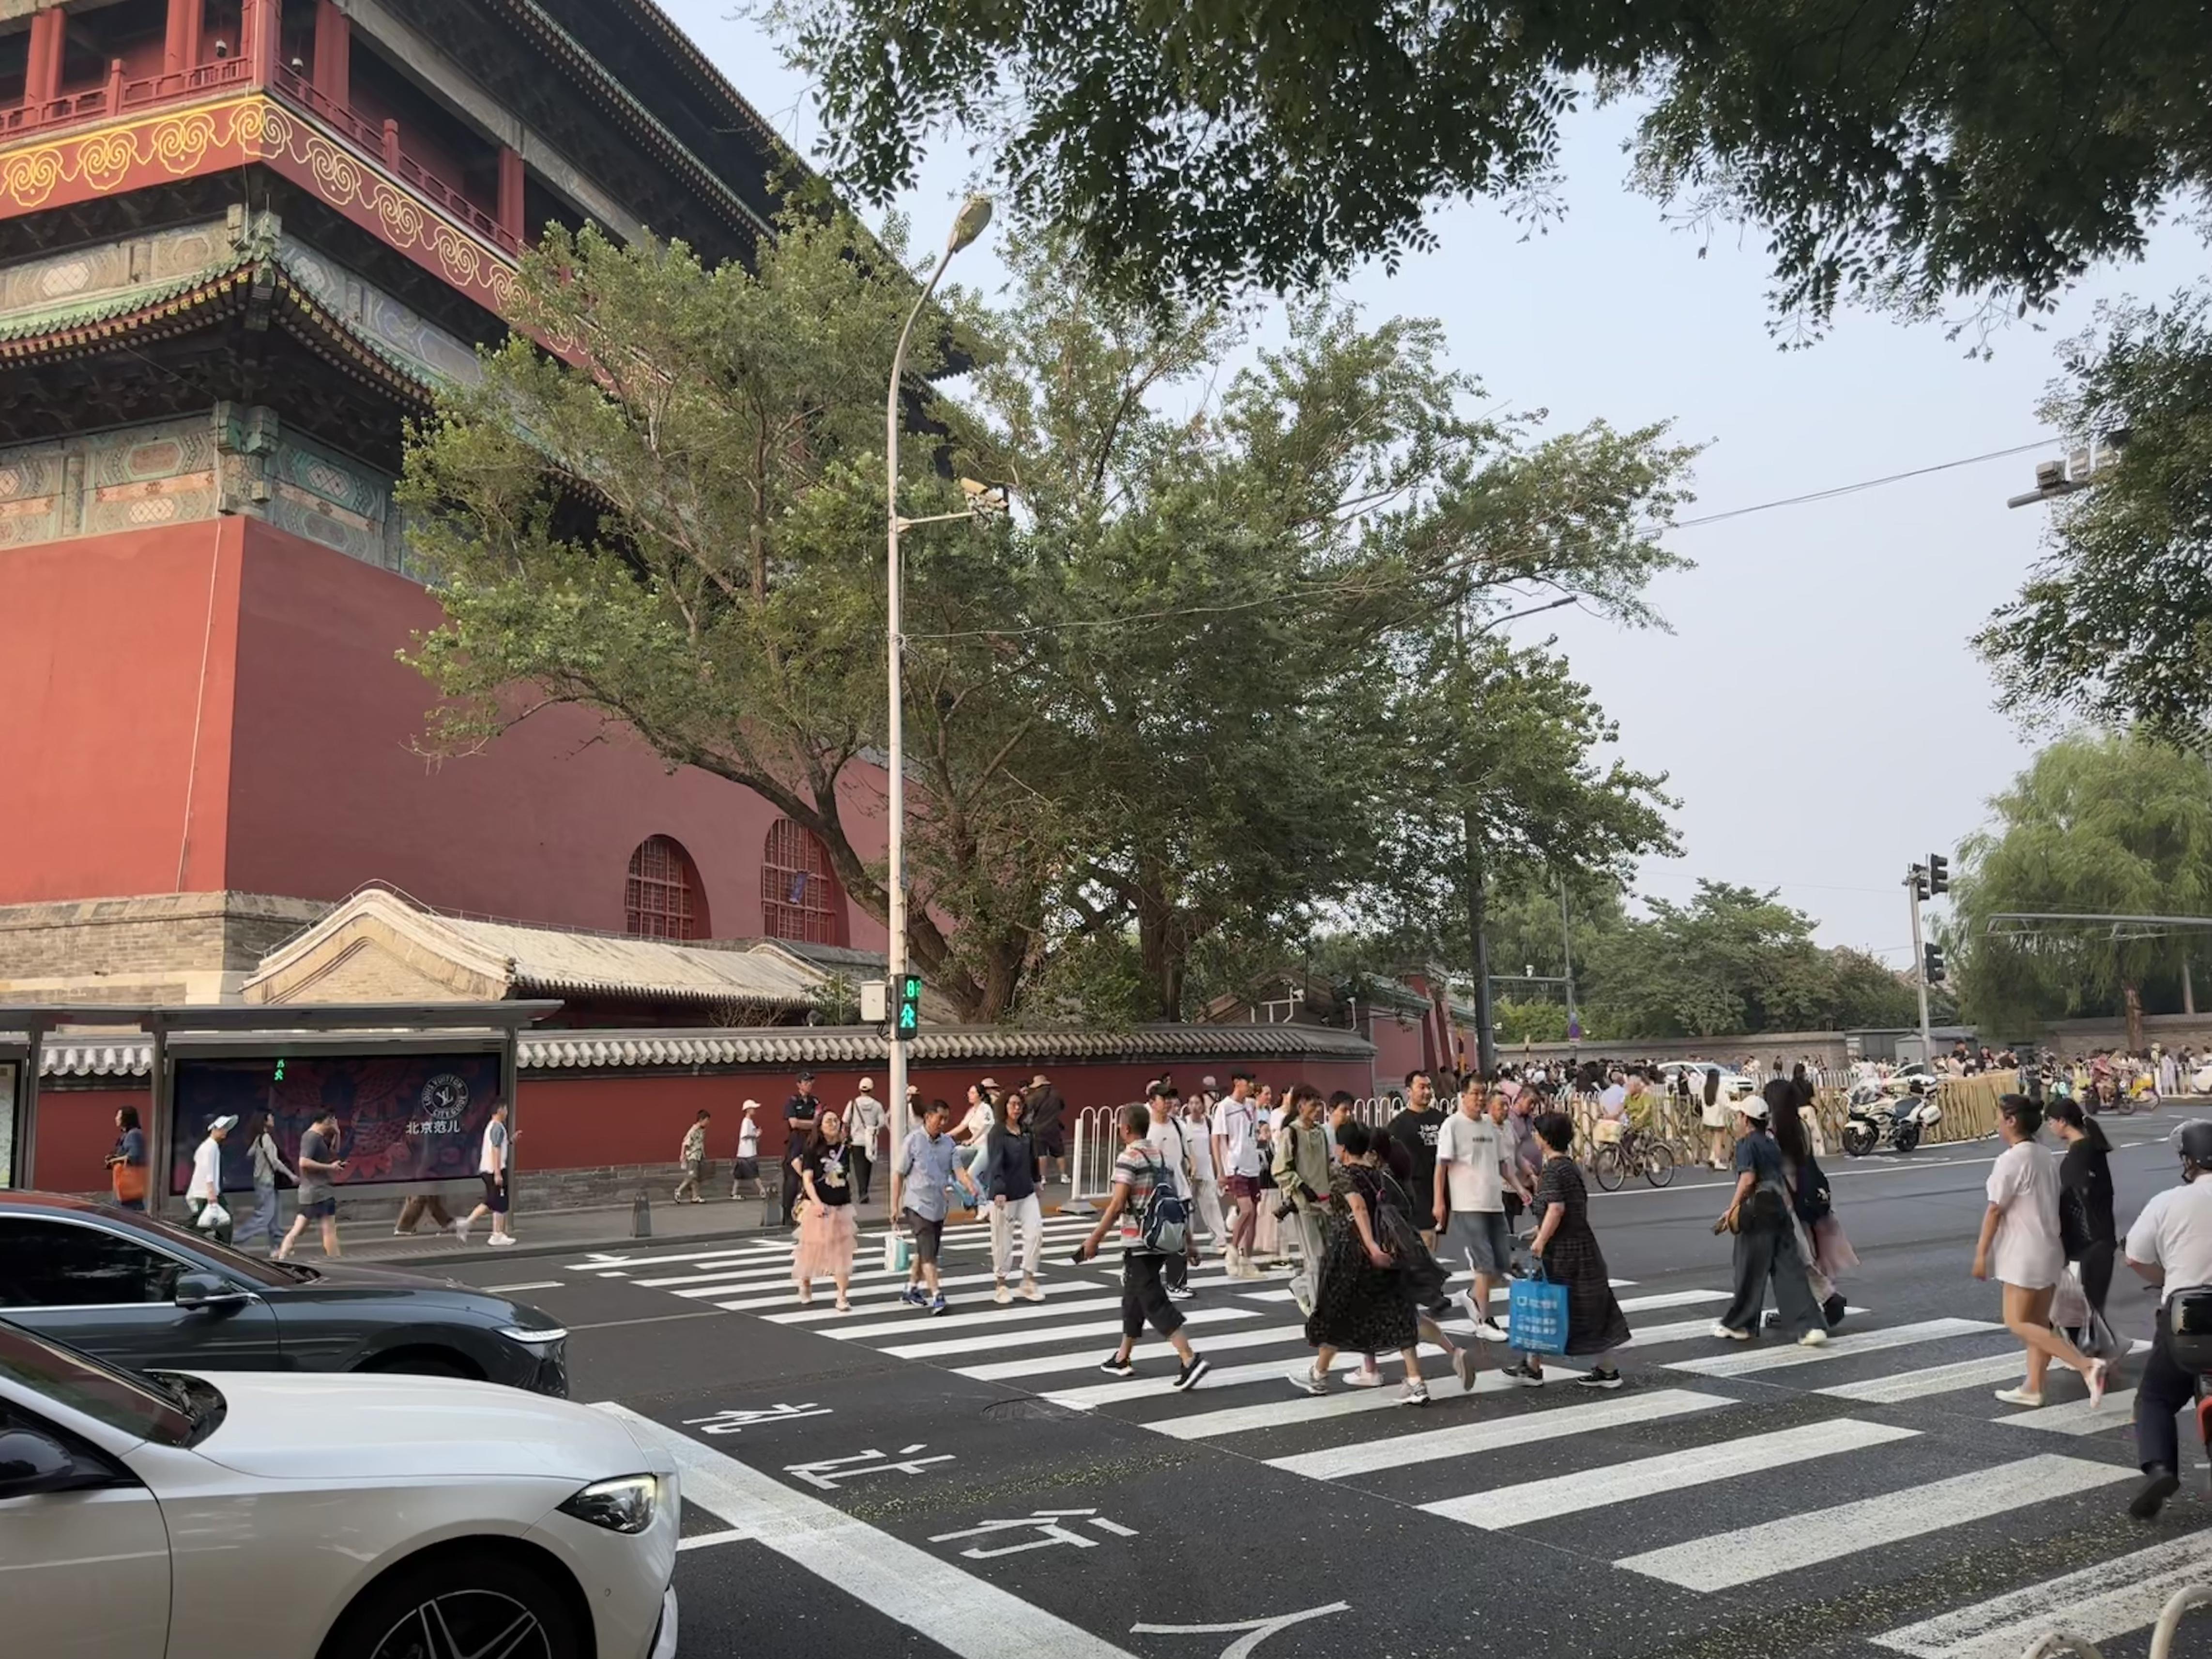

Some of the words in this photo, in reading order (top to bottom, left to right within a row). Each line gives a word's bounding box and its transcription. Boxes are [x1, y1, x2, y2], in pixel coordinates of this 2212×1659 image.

[423, 1084, 435, 1106] LOUIS
[433, 1108, 450, 1118] CITY
[405, 1120, 460, 1134] 北京范儿
